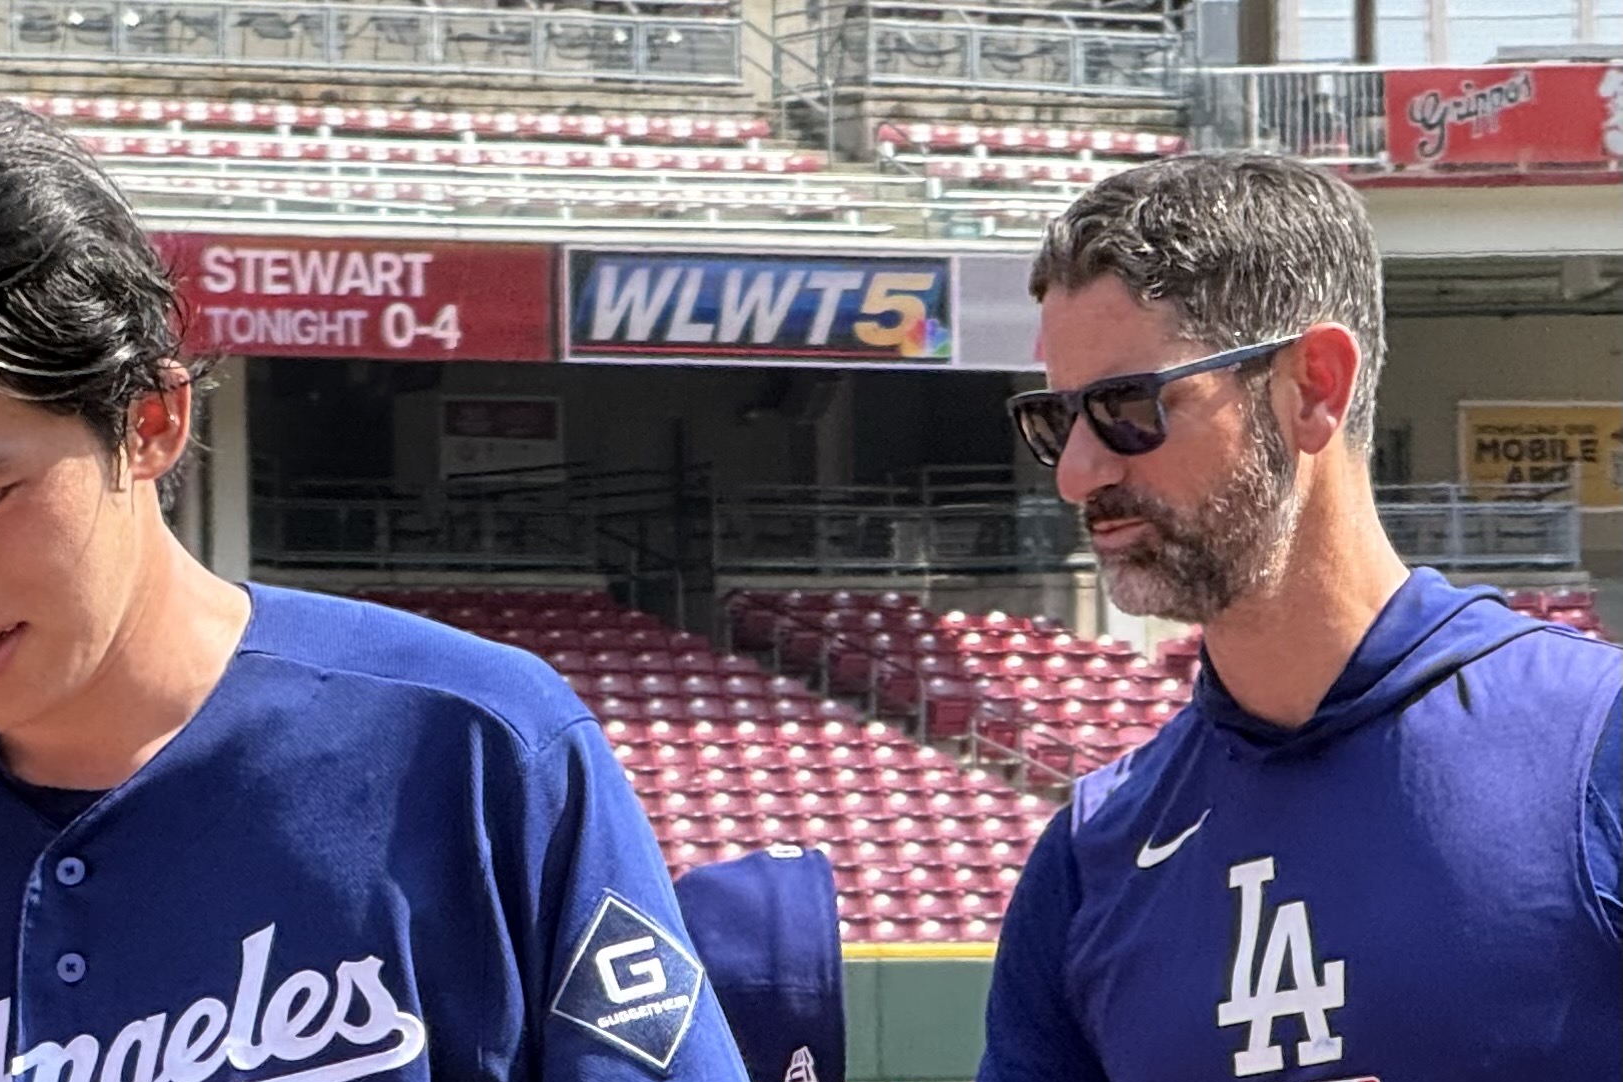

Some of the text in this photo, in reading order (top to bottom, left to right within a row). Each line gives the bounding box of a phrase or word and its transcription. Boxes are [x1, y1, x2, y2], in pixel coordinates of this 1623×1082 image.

[201, 247, 432, 298] STEWART
[201, 302, 461, 350] TONIGHT 0-4
[1476, 438, 1598, 463] MOBILE
[595, 936, 667, 1003] G
[1218, 856, 1345, 1077] LA
